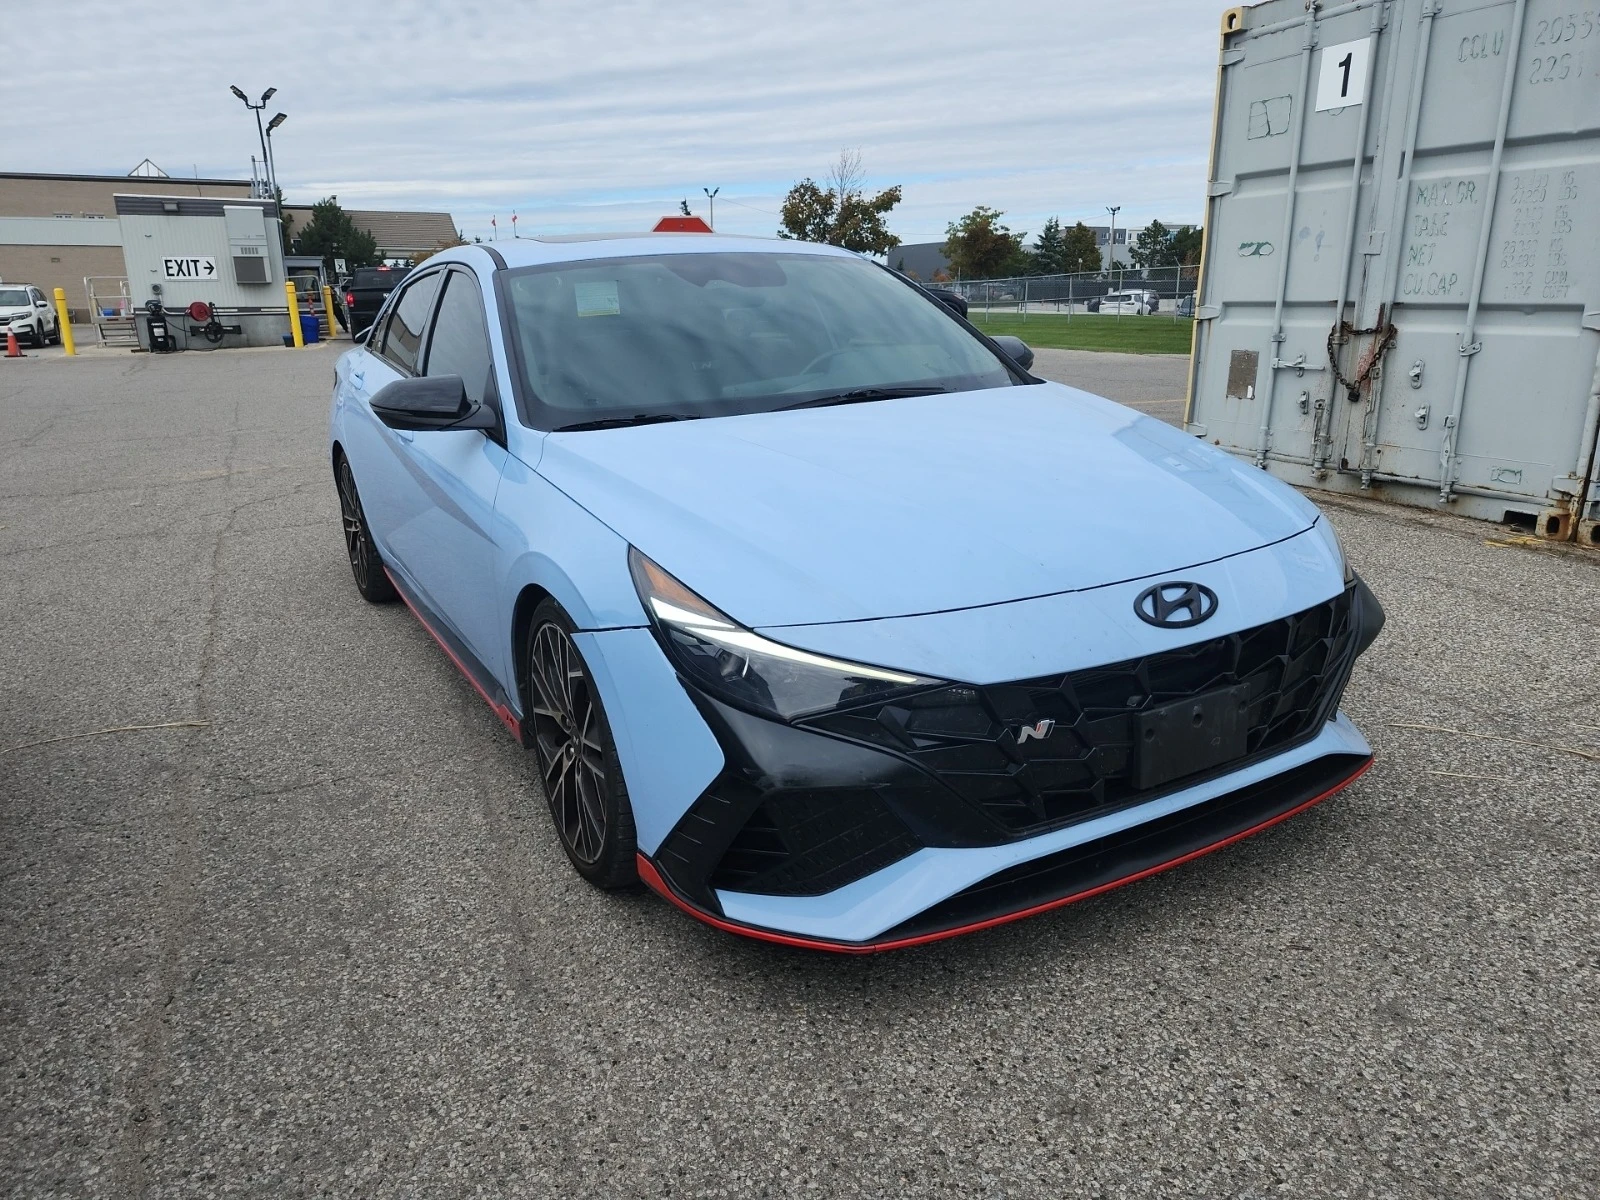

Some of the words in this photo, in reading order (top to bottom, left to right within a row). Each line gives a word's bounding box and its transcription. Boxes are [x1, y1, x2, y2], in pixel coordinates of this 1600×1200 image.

[1534, 10, 1600, 48] 2055
[1339, 52, 1352, 97] 1
[164, 259, 200, 277] EXIT
[1406, 243, 1436, 267] NET
[1016, 719, 1055, 745] N
